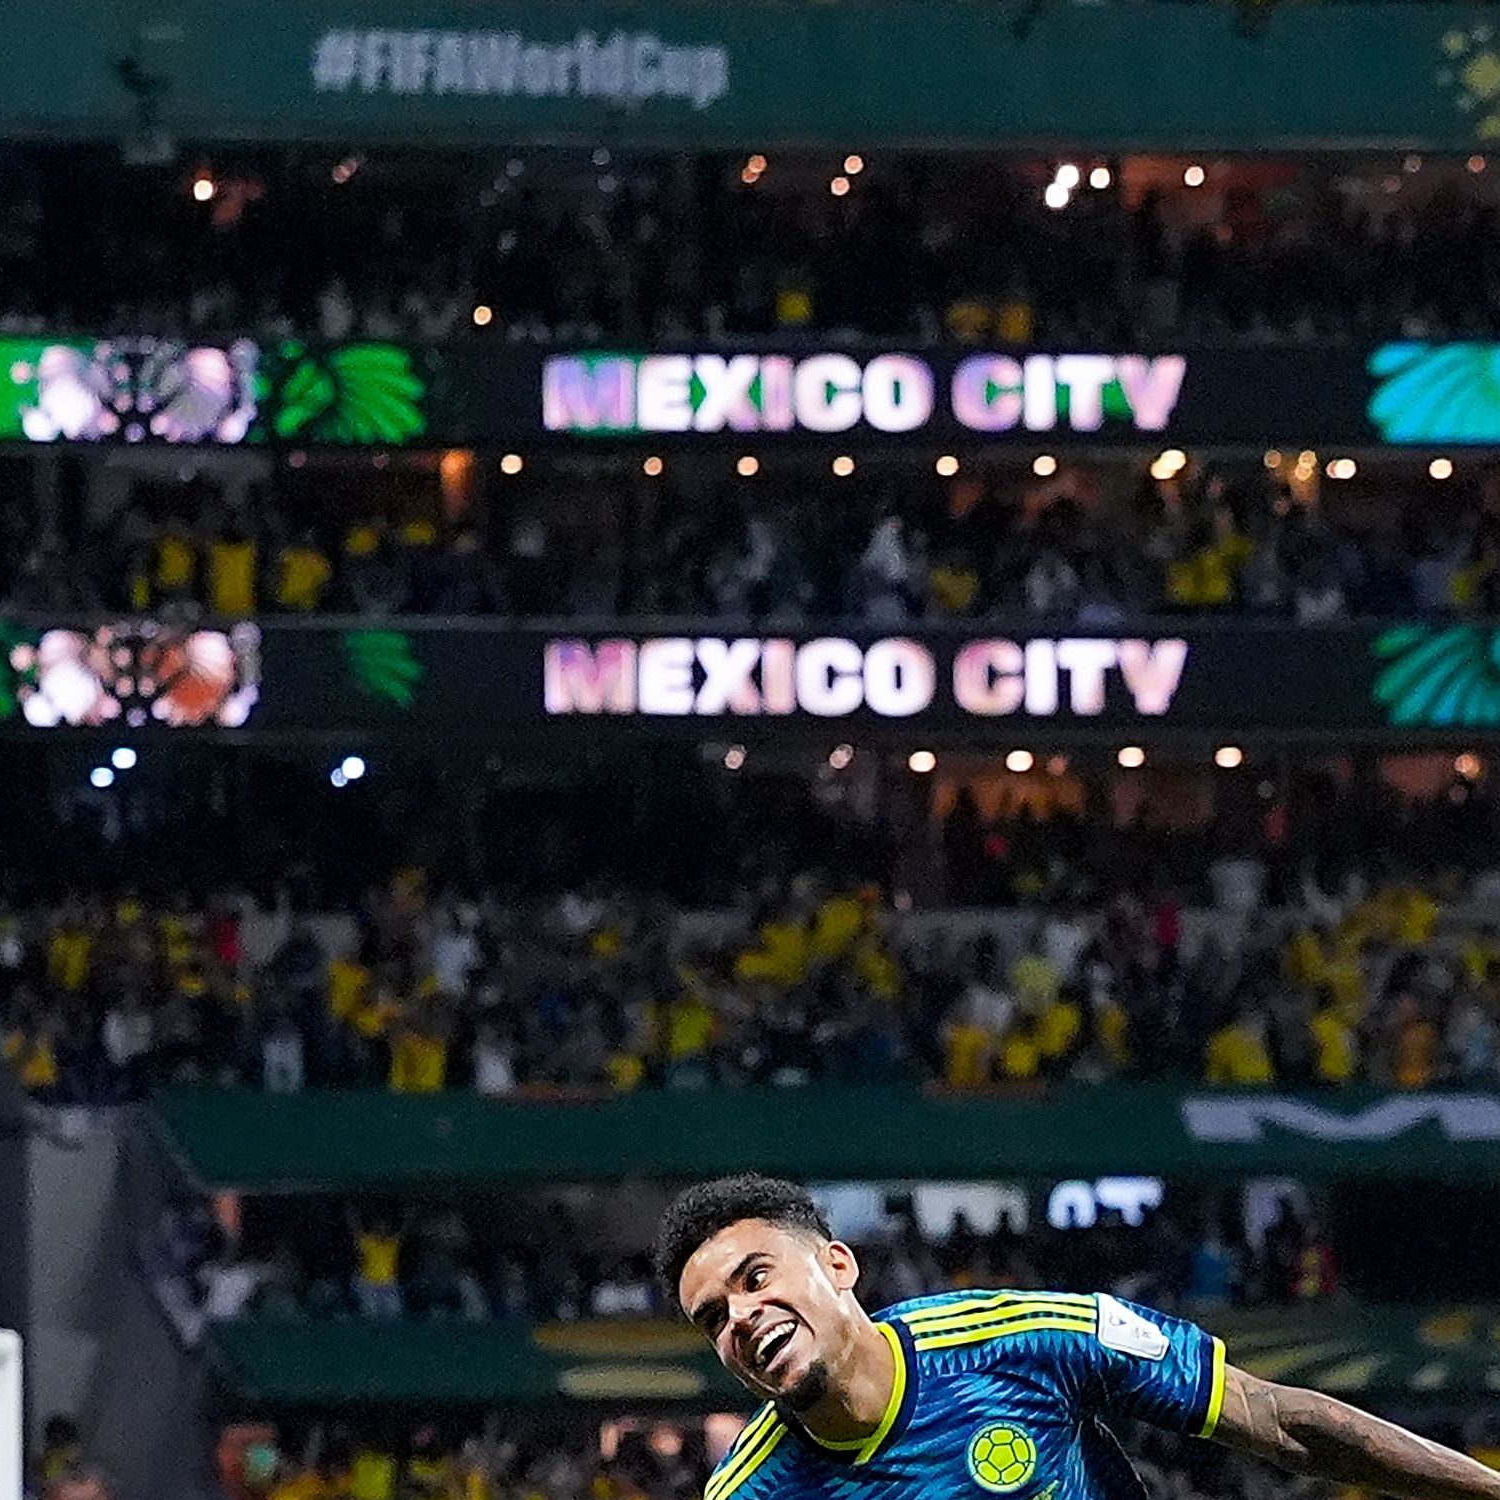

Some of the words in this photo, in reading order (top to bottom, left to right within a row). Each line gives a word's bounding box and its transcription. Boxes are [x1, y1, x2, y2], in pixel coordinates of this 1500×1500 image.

[543, 354, 935, 432] MEXICO
[951, 354, 1187, 432] CITY
[544, 638, 936, 716] MEXICO
[952, 638, 1188, 716] CITY
